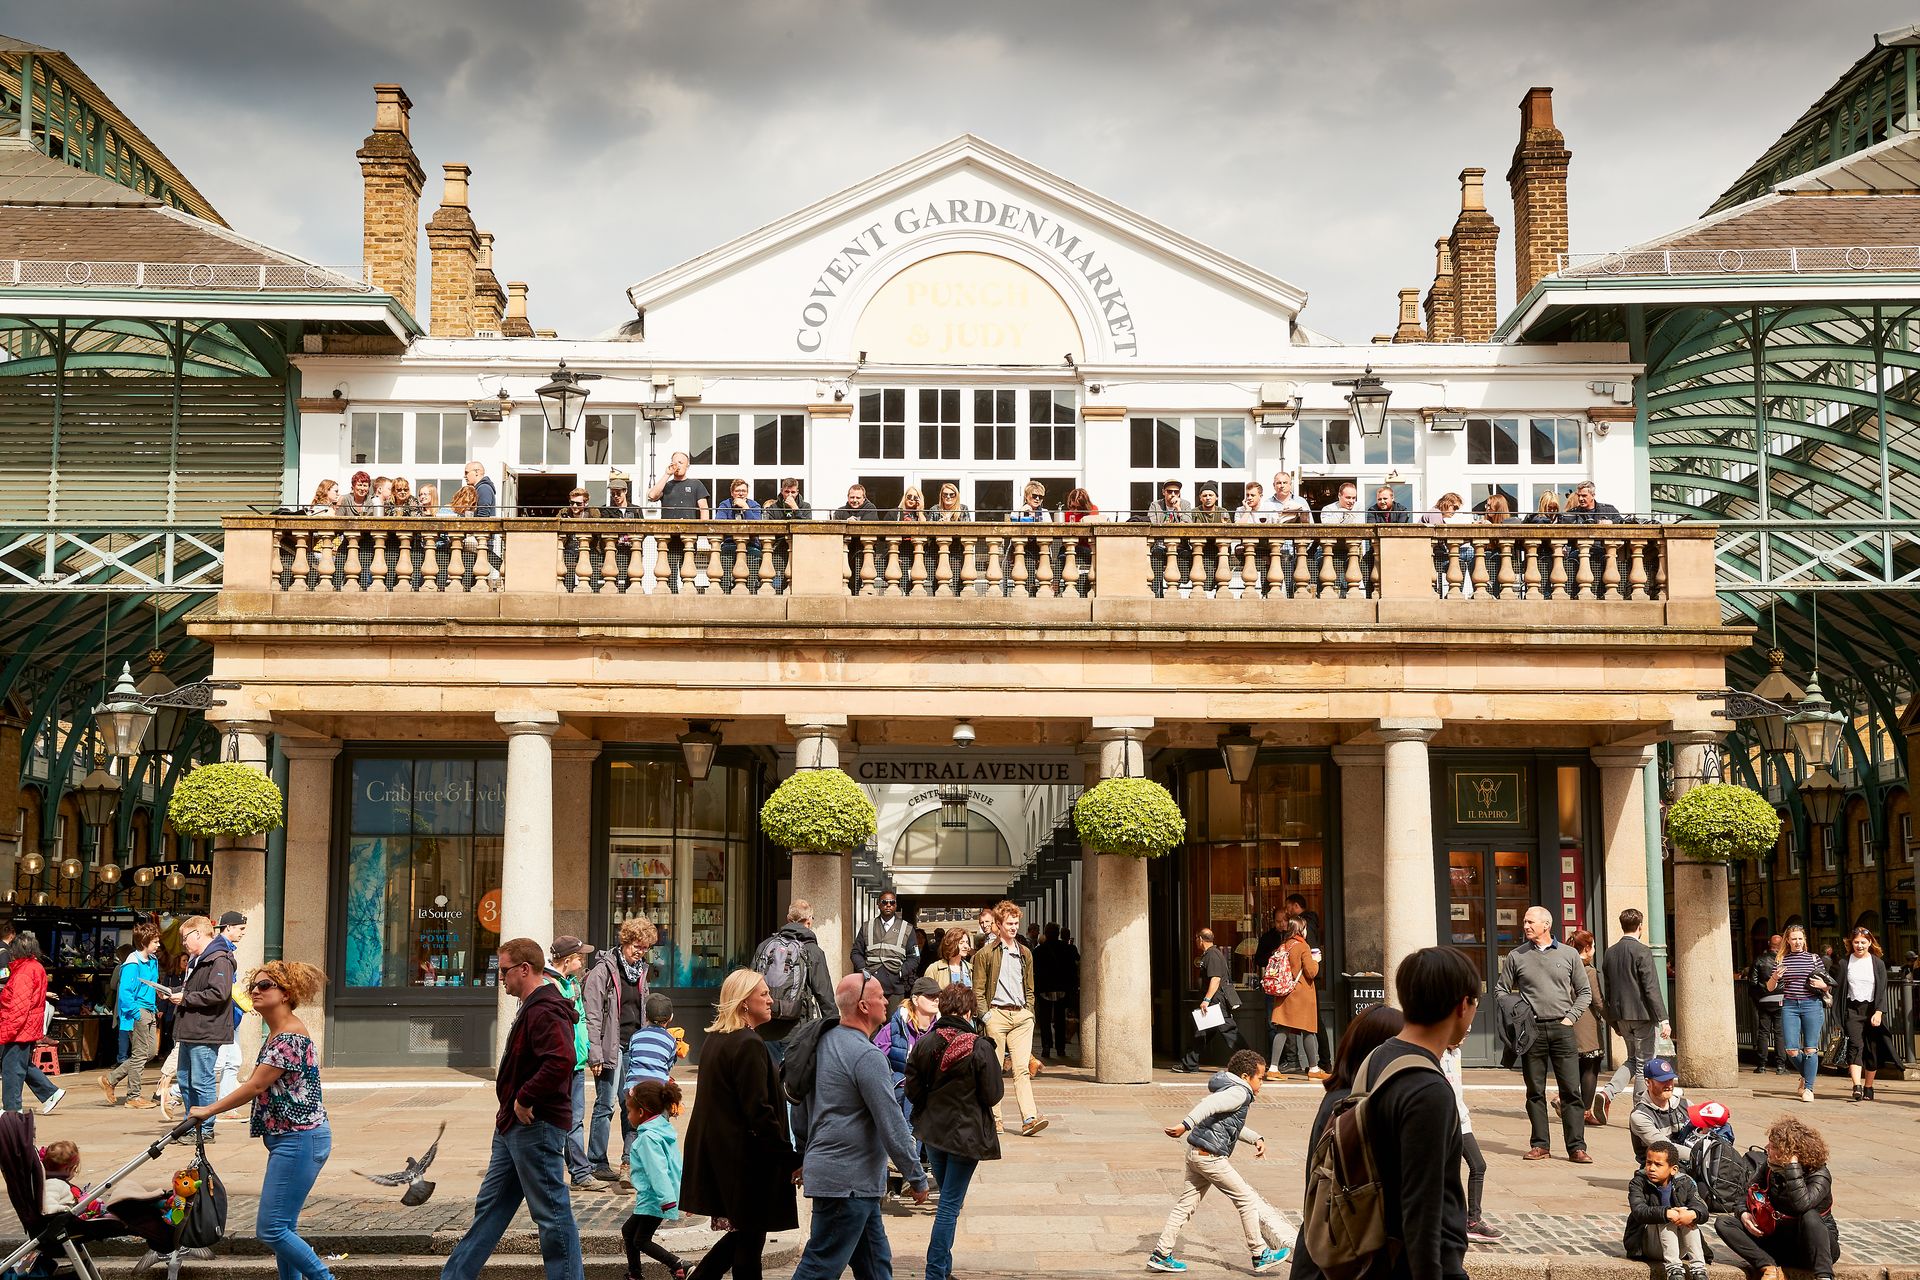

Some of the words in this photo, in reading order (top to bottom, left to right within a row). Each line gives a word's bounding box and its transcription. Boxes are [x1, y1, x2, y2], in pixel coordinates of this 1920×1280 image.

[796, 222, 888, 353] COVENT
[893, 198, 1049, 239] GARDEN
[1047, 222, 1138, 358] MARKET
[906, 282, 1030, 308] PUNCH
[906, 323, 930, 348] &
[938, 320, 1029, 353] JUDY
[859, 762, 969, 780] CENTRAL
[972, 762, 1069, 780] AVENUE
[446, 782, 462, 802] &
[463, 780, 507, 808] Evely
[908, 789, 940, 807] CENTR
[968, 789, 995, 806] ENUE
[1468, 810, 1477, 819] IL
[1478, 810, 1508, 819] PAPIRO
[418, 908, 428, 919] La
[428, 907, 462, 919] Source
[419, 934, 460, 943] POWER
[1353, 989, 1385, 998] LITTE
